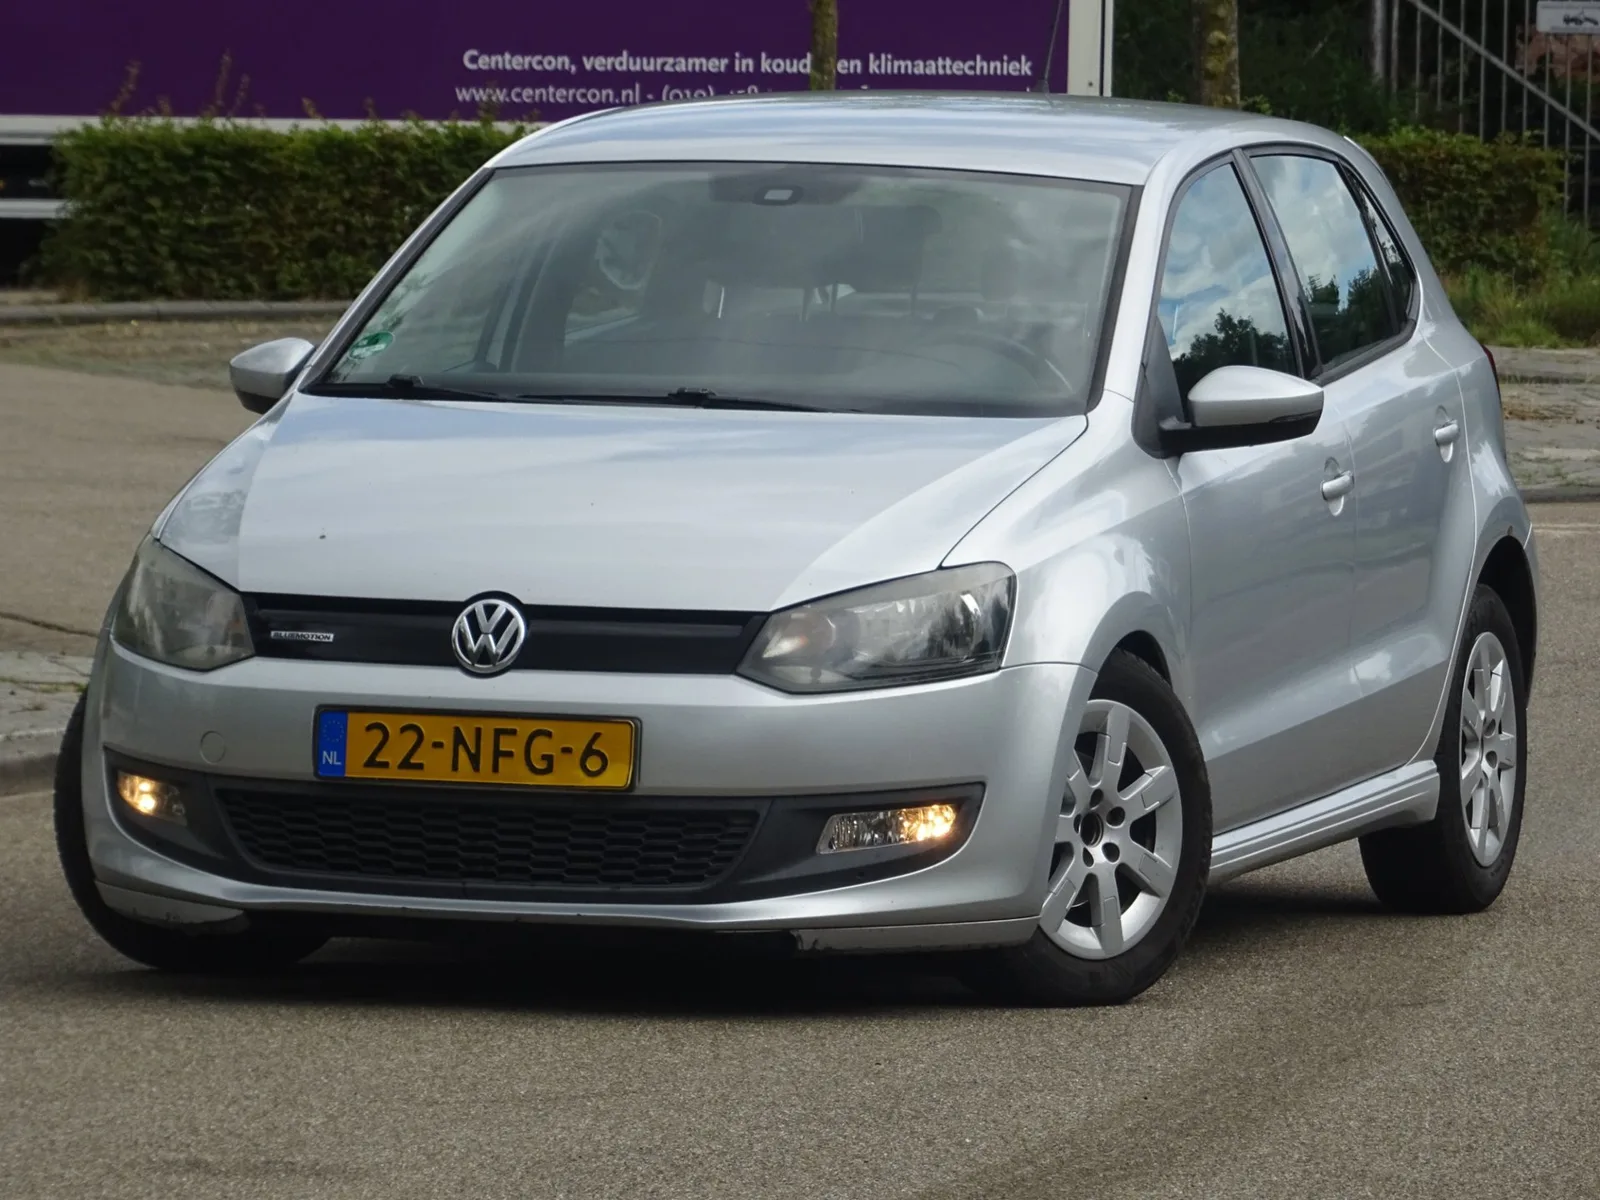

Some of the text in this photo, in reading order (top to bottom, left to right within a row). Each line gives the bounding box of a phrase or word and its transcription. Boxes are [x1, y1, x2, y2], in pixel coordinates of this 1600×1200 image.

[462, 49, 1033, 76] Centercon, verduurzamer in koud en klimaattechniek
[455, 82, 640, 104] www.centercon.nl
[322, 750, 342, 766] NL
[363, 721, 609, 778] 22-NFG-6
